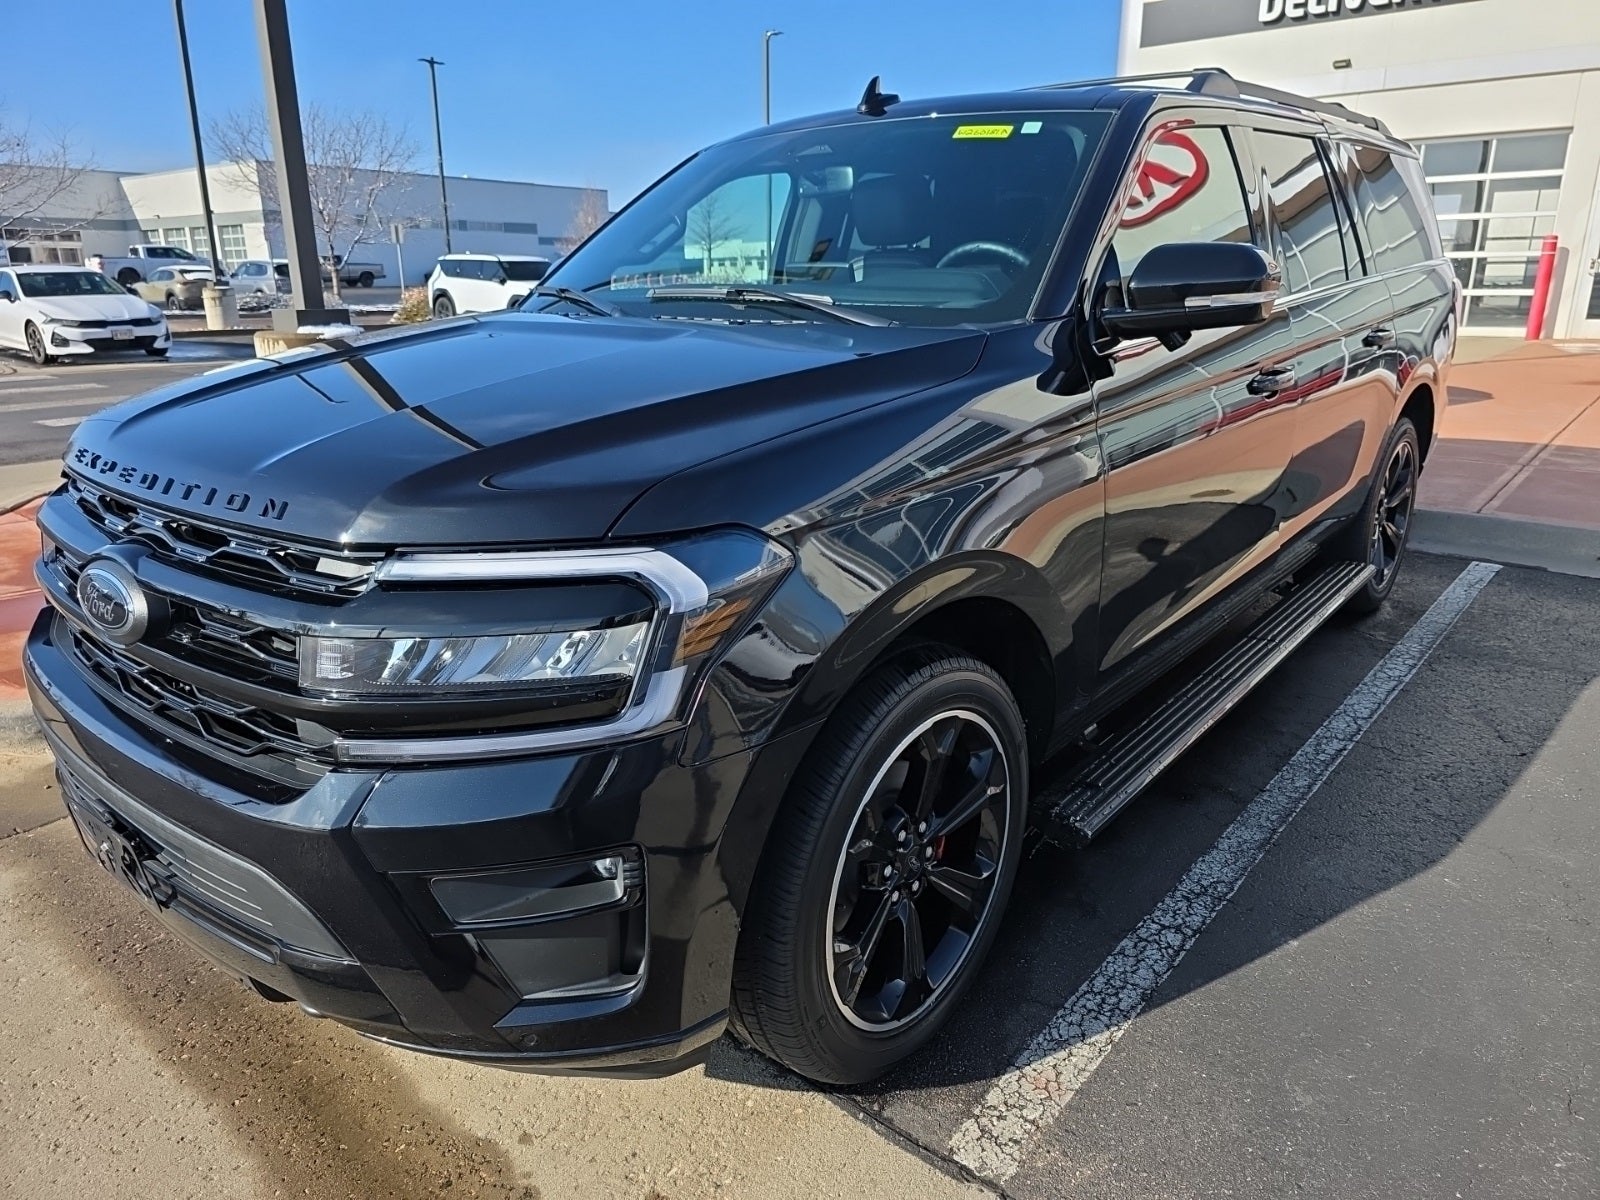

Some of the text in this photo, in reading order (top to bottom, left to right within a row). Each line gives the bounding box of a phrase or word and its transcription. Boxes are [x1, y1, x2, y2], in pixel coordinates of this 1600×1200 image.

[1258, 0, 1402, 22] DELIV
[75, 447, 289, 521] EXPEDITION
[84, 581, 115, 622] Ford
